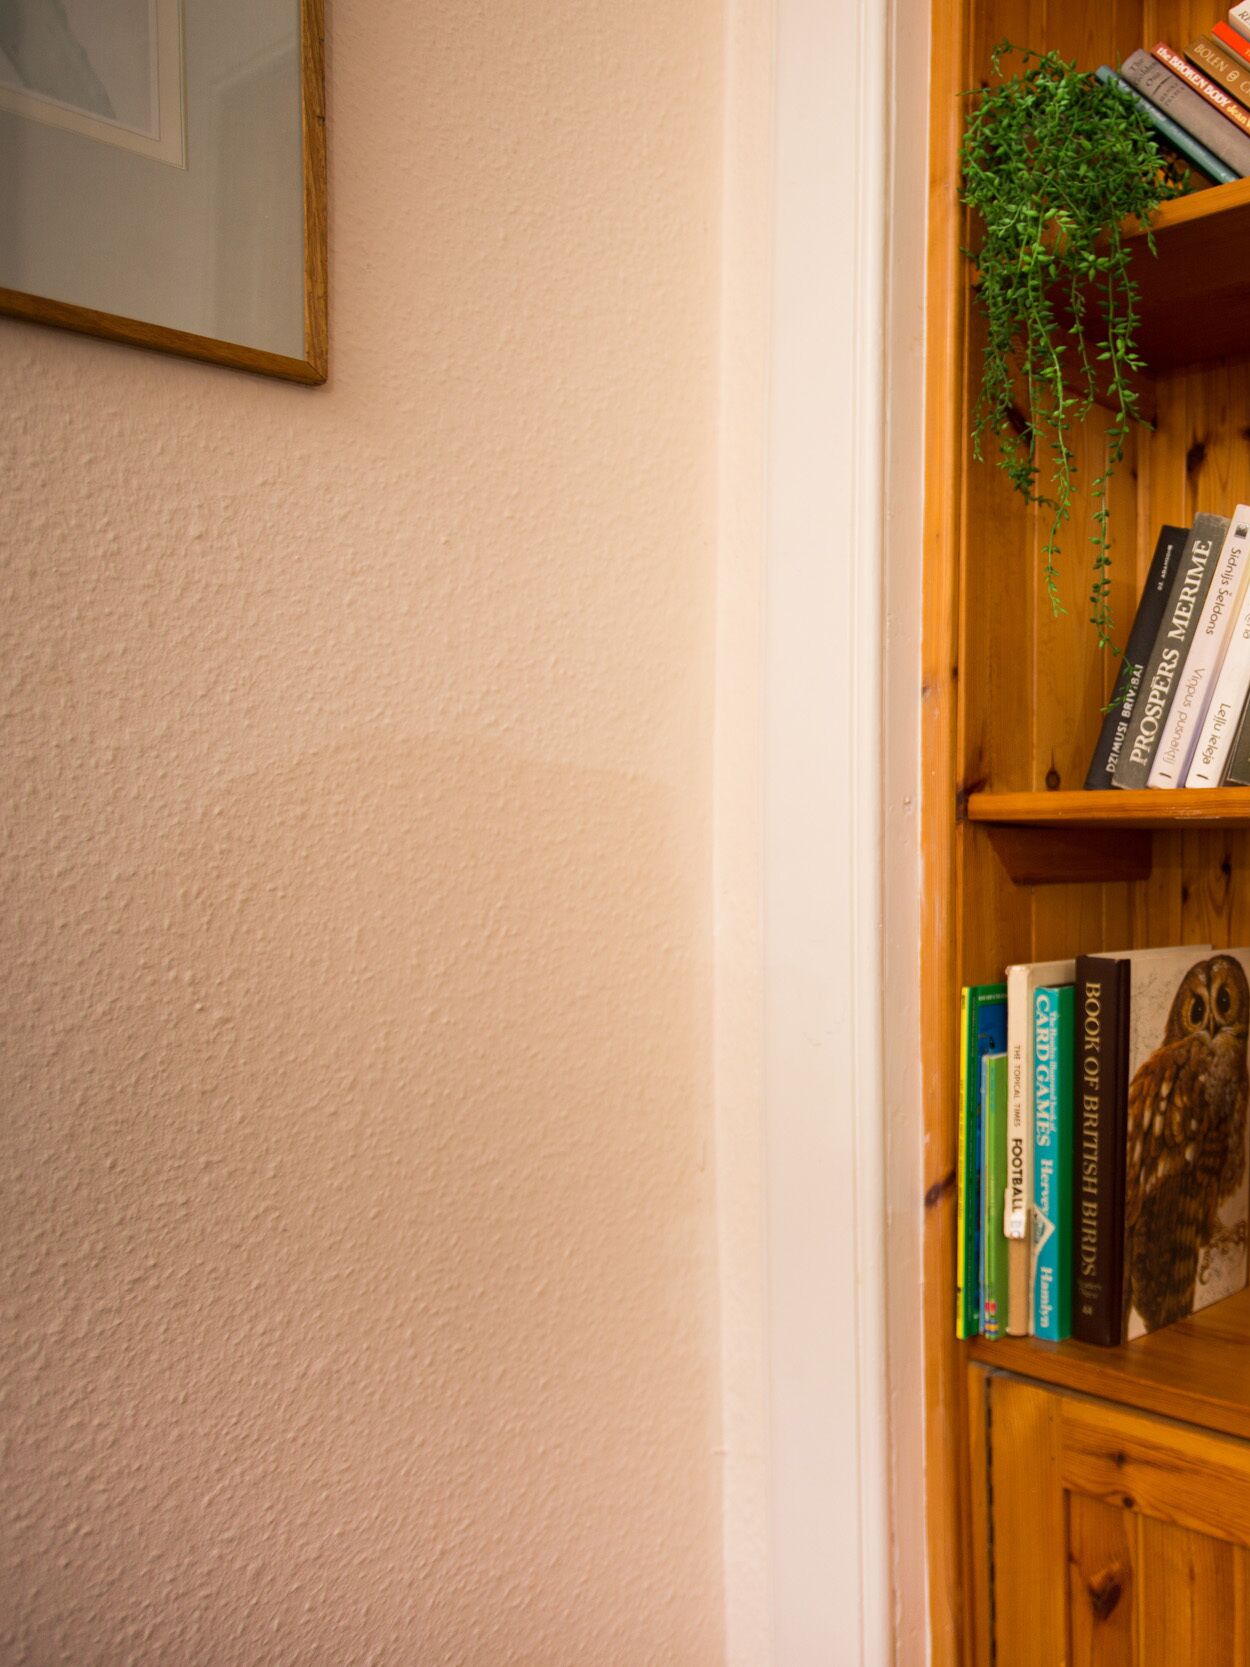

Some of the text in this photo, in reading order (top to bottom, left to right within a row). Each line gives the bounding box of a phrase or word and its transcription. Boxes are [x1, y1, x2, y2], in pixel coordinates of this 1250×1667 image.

[1156, 46, 1172, 62] the
[1169, 54, 1209, 91] BROKEN
[1203, 83, 1231, 108] BODY
[1226, 103, 1248, 127] Jean
[1194, 44, 1229, 73] BOLEN
[1205, 548, 1242, 637] Sidnijs Šeldons
[1129, 539, 1213, 768] PROSPĒRS MERIMĒ
[1106, 721, 1128, 774] DZIMUSI
[1084, 981, 1100, 1051] BOOK
[1013, 1045, 1021, 1127] THE TOPICAL TIMES
[1036, 994, 1051, 1147] CARD GAMES
[1083, 1058, 1099, 1090] OF
[1011, 1138, 1023, 1213] FOOTBALL
[1082, 1094, 1099, 1195] BRITISH
[1081, 1201, 1098, 1277] BIRDS
[1040, 1266, 1053, 1328] Hamlyn
